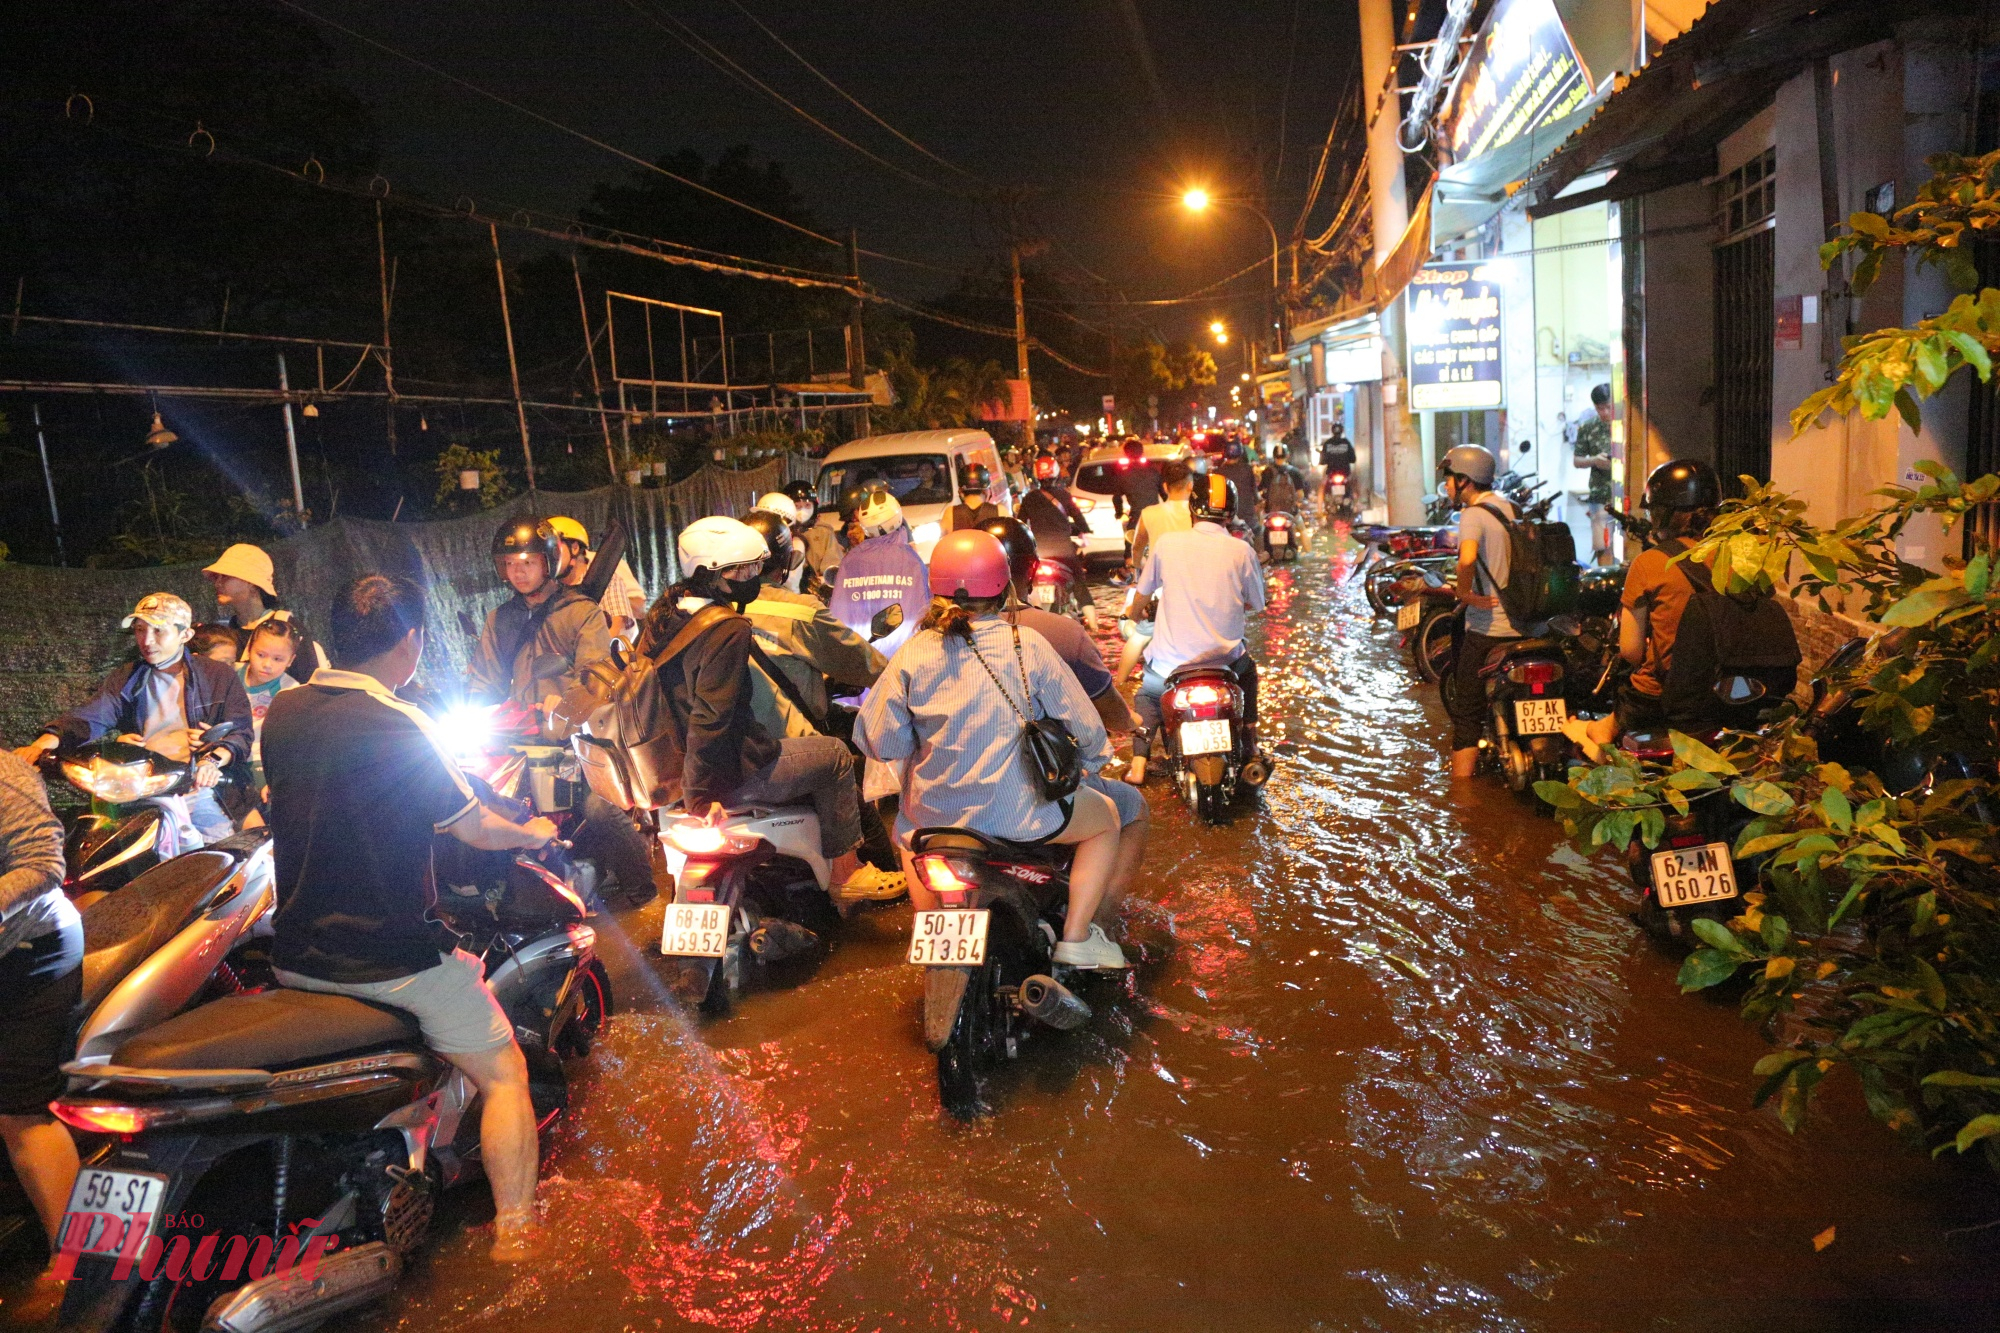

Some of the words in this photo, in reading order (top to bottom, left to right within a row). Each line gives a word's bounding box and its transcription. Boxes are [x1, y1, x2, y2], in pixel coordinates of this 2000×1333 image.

[1413, 269, 1468, 285] Shop
[843, 575, 894, 588] PETROVIETNAM
[895, 575, 913, 586] GAS
[862, 591, 881, 600] 1900
[882, 590, 902, 599] 3131
[1522, 701, 1558, 716] 67-AK
[1522, 716, 1563, 732] 135.25
[772, 819, 804, 827] VISION
[1664, 850, 1719, 877] 62-AN
[1003, 865, 1050, 884] SONIC
[1664, 873, 1731, 902] 160.26
[676, 910, 718, 930] 68-AB
[924, 914, 976, 935] 50-Y1
[669, 932, 722, 953] 159.52
[914, 939, 980, 961] 513.64
[83, 1172, 150, 1213] 59-S1
